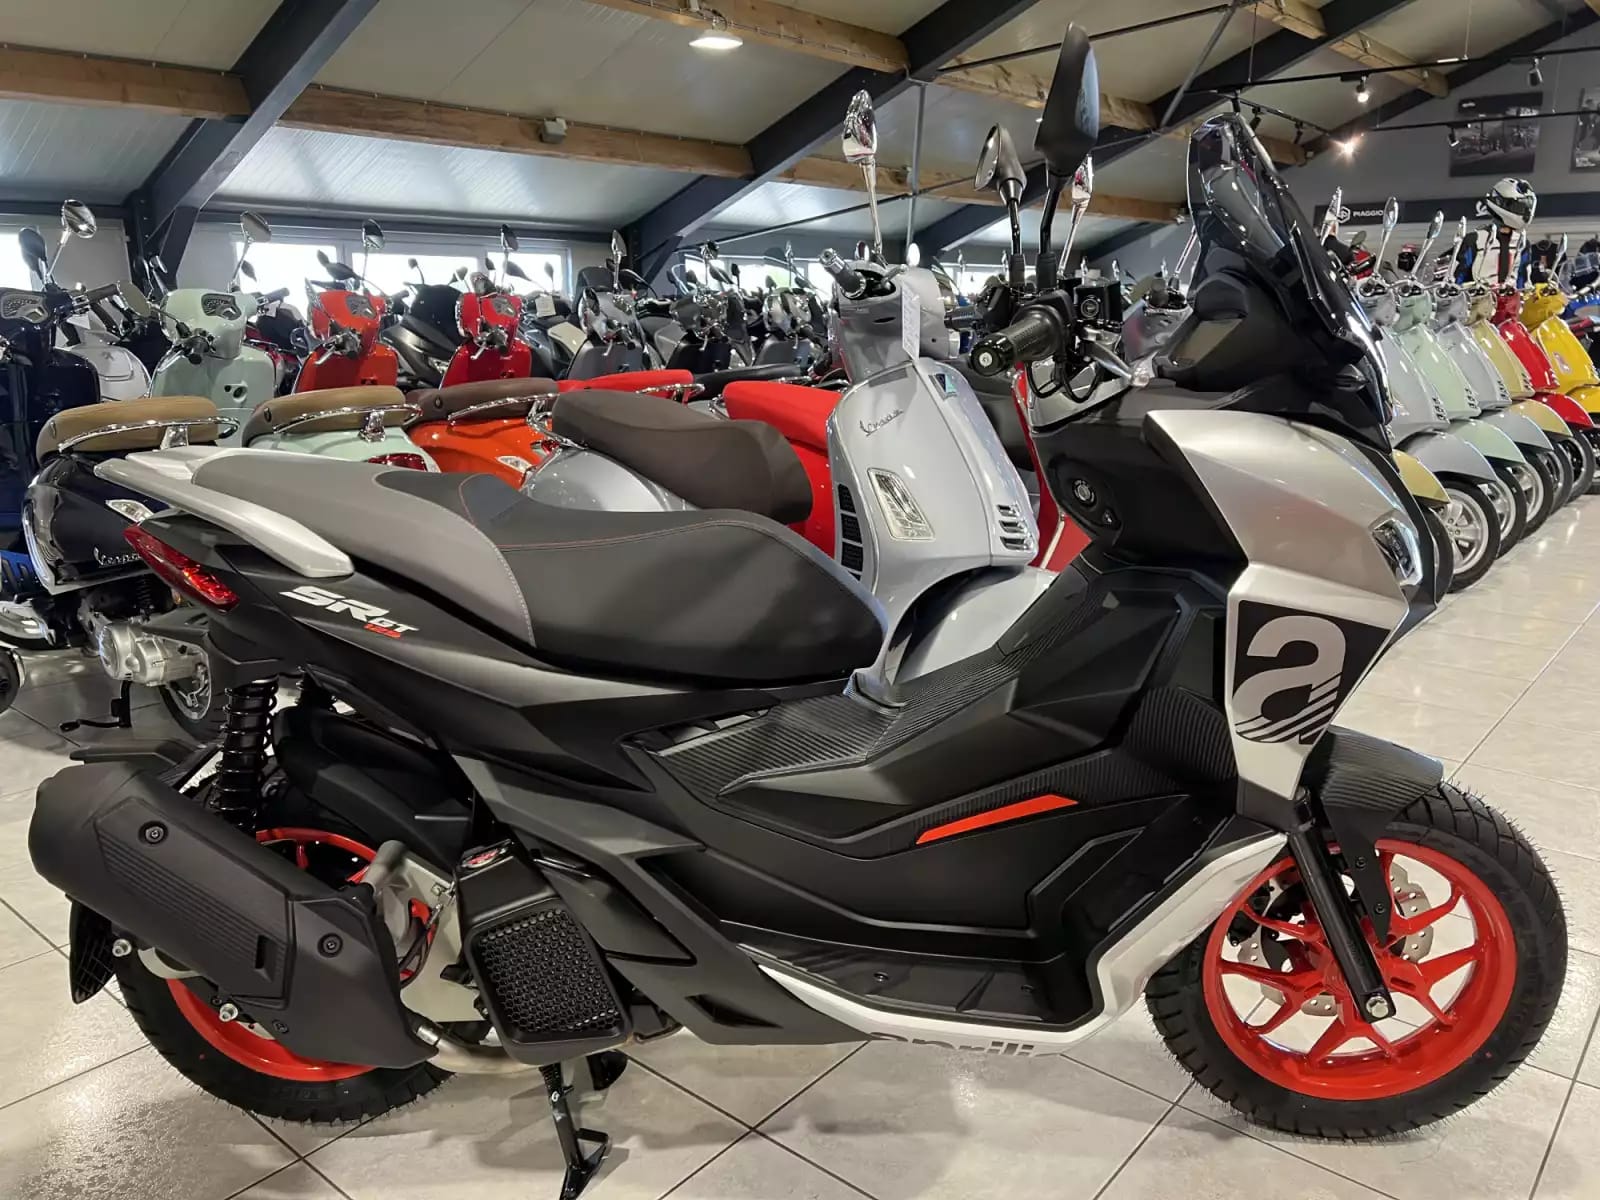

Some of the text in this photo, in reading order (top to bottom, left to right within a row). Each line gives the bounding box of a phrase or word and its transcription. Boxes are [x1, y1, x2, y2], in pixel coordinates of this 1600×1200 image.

[1353, 209, 1384, 218] PIAGGIO
[859, 409, 905, 437] Vespa
[278, 585, 390, 623] SR
